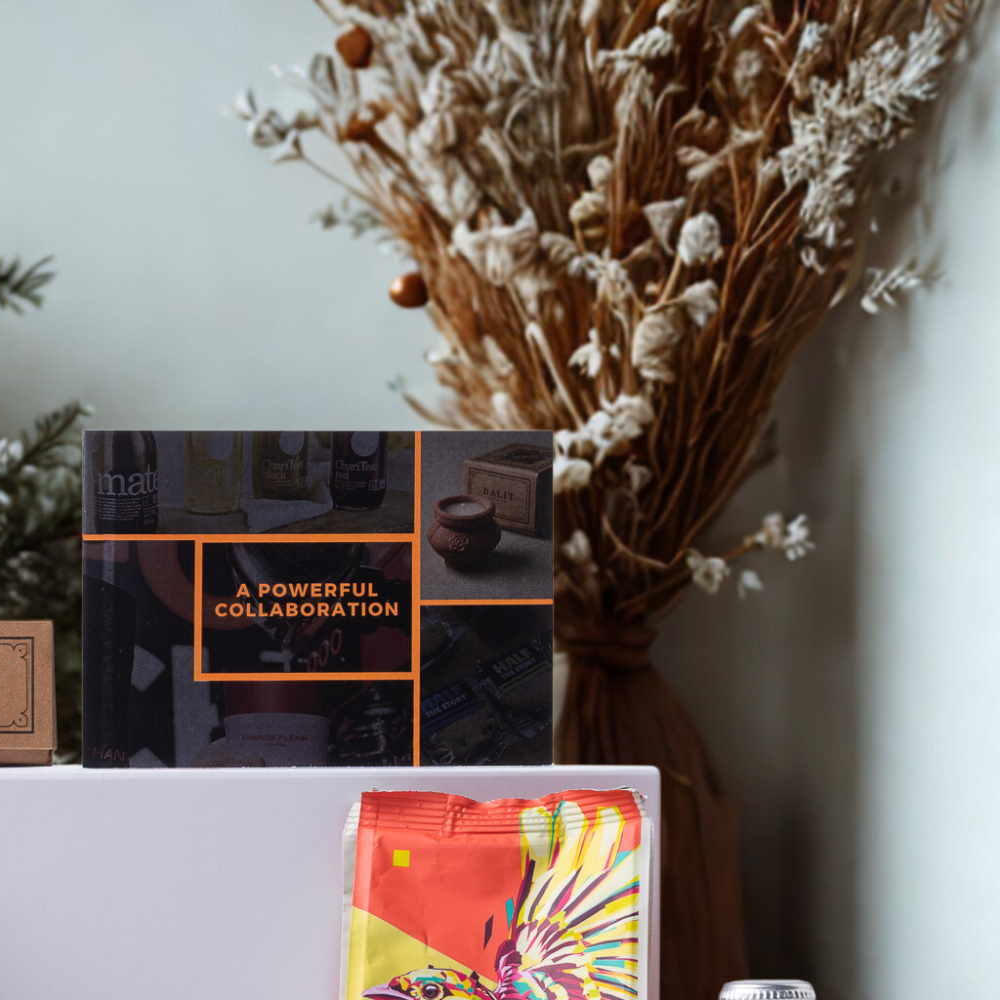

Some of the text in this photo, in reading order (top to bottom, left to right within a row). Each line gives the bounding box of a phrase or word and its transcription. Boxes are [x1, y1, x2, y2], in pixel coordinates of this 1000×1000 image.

[483, 487, 514, 502] DALIT
[236, 582, 378, 598] A POWERFUL
[214, 602, 399, 618] COLLABORATION
